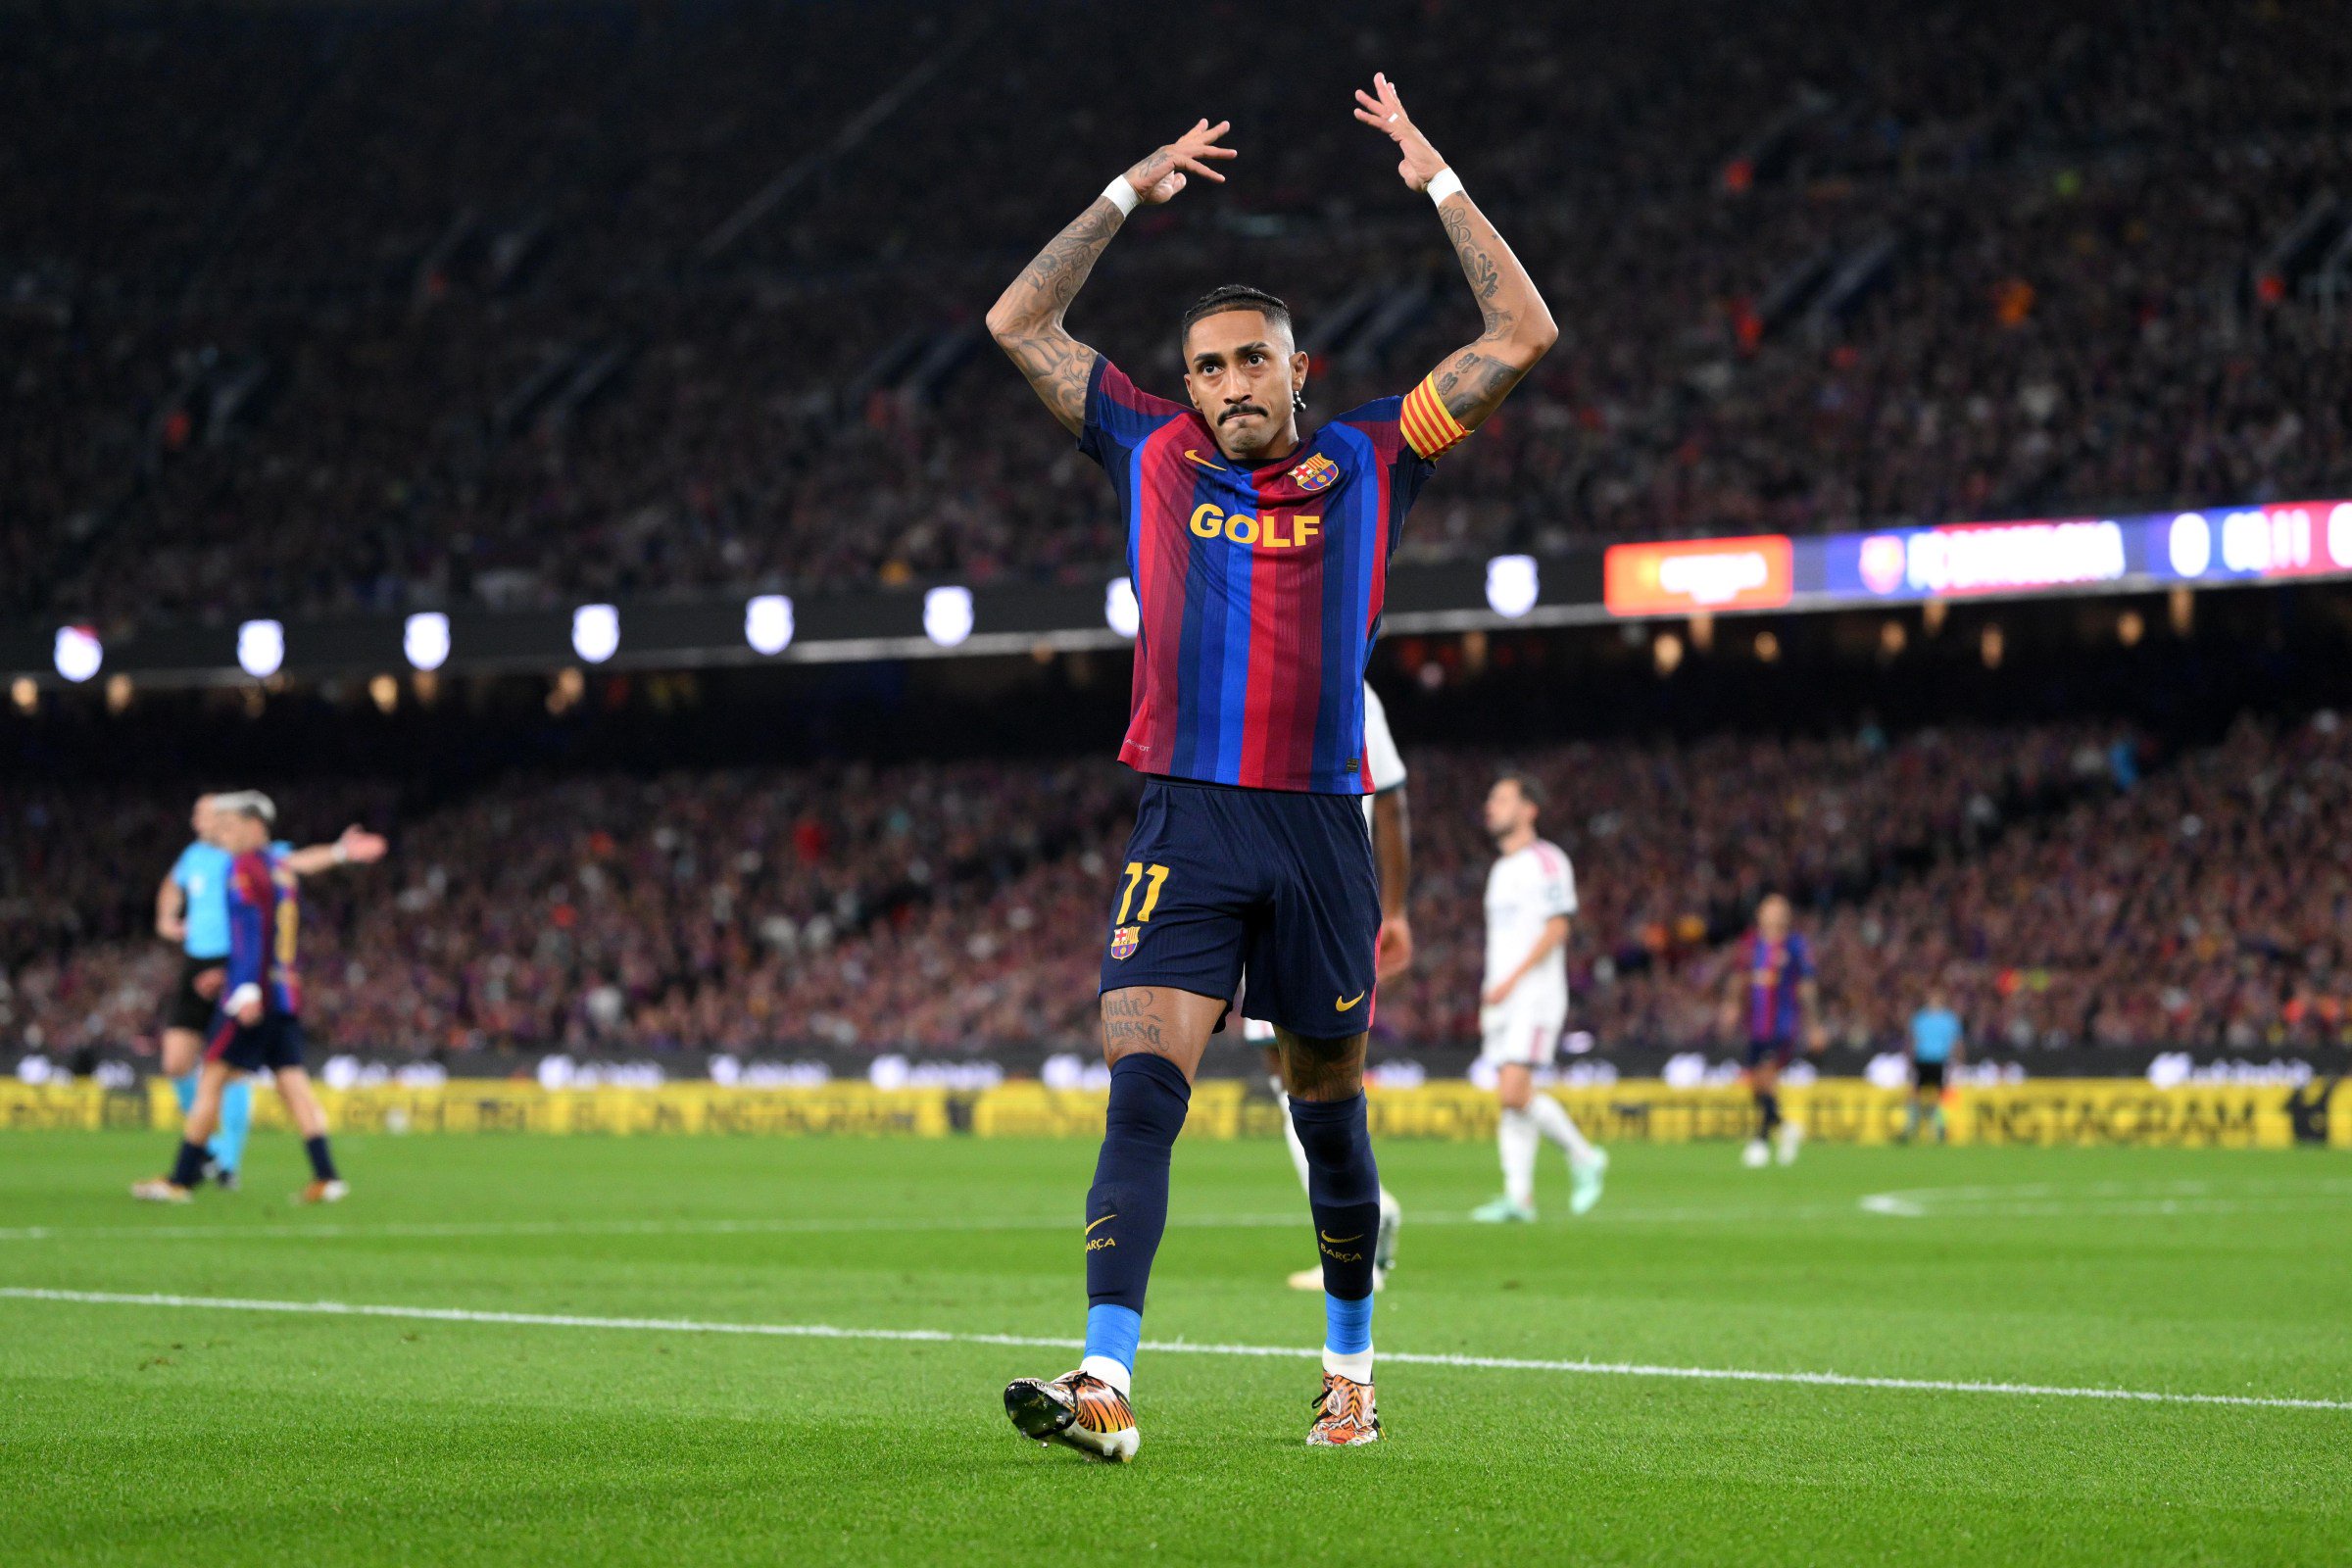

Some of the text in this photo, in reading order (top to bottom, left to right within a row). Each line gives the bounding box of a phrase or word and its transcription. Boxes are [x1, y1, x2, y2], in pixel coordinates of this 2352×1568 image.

[1190, 503, 1320, 548] GOLF
[1115, 861, 1169, 925] 11
[1085, 1237, 1116, 1253] ARÇA
[1320, 1242, 1362, 1263] BARÇA
